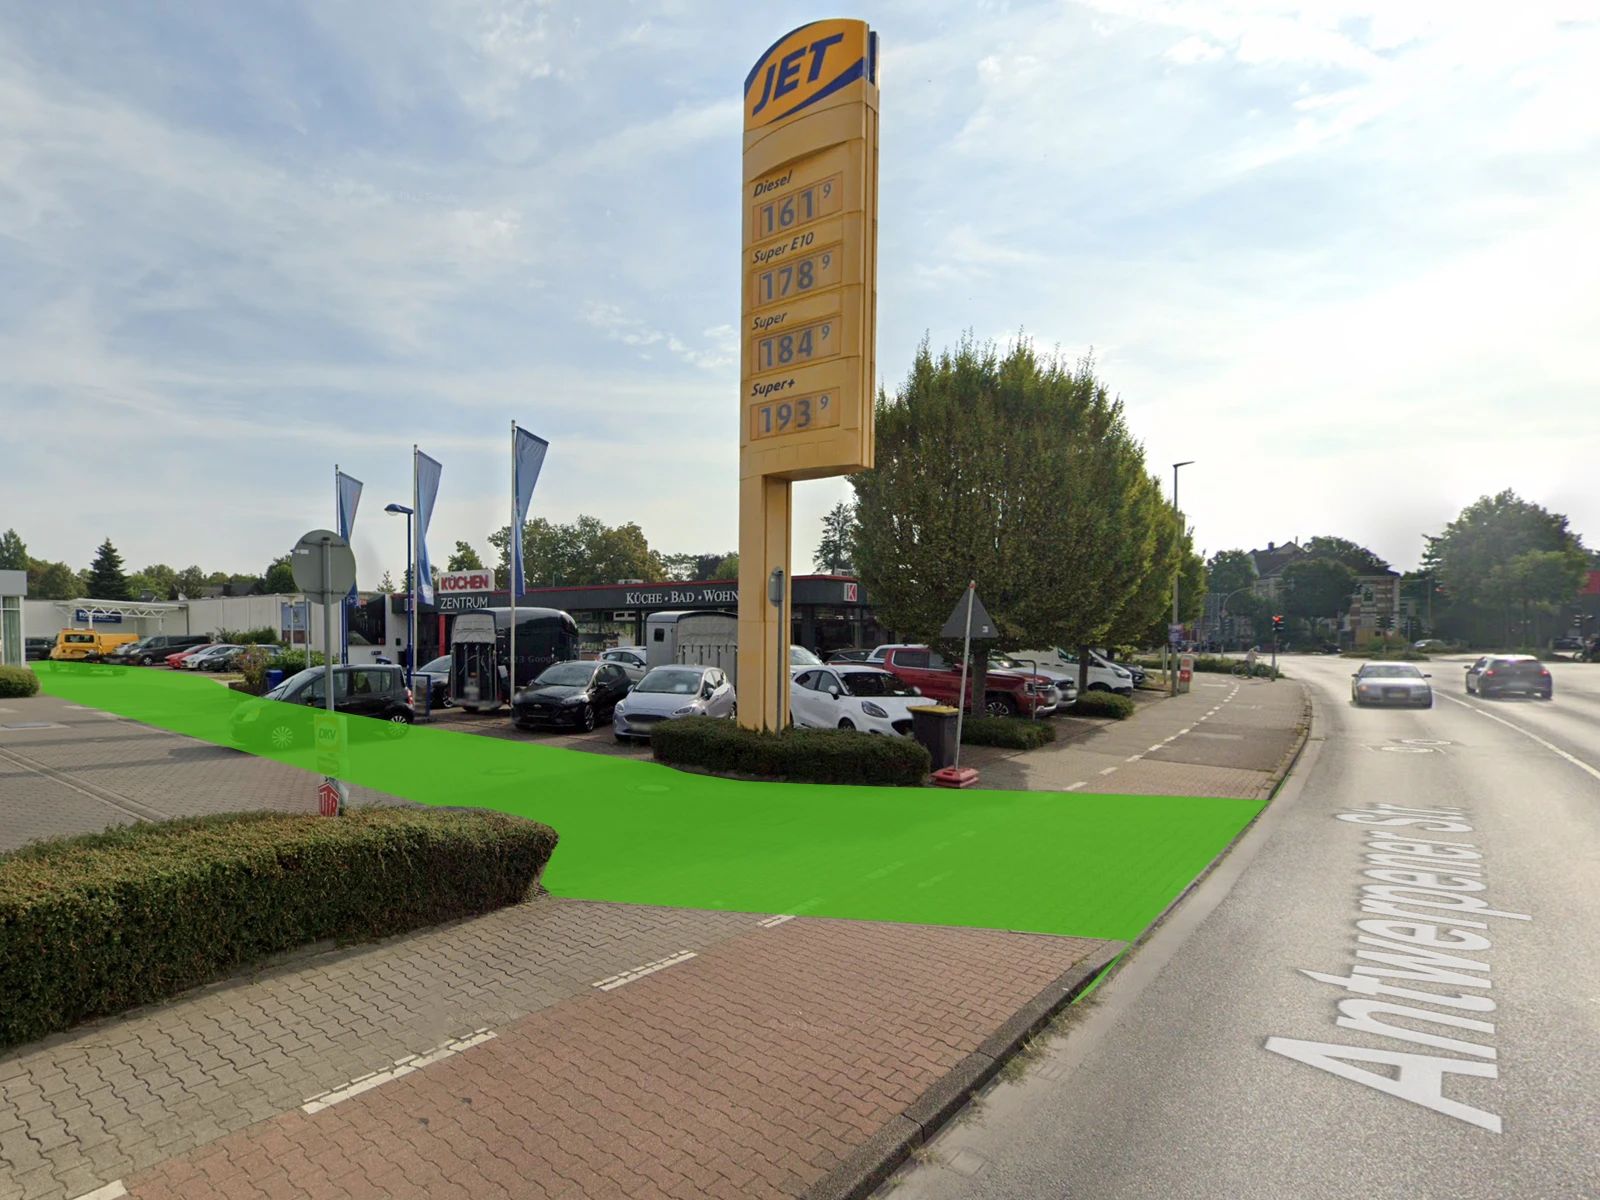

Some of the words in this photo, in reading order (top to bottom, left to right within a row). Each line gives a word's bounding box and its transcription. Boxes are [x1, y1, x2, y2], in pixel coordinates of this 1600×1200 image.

[752, 32, 844, 117] JET
[753, 169, 793, 198] Diesel
[762, 189, 815, 233] 161
[753, 244, 788, 264] Super
[790, 231, 814, 251] E10
[762, 258, 814, 300] 178
[752, 312, 788, 331] Super
[762, 328, 813, 368] 184
[751, 378, 795, 397] Super+
[760, 399, 812, 433] 193
[441, 574, 489, 591] KÜCHEN
[440, 596, 488, 610] ZENTRUM
[319, 728, 336, 740] DKV
[1335, 803, 1475, 832] Str.
[1264, 829, 1533, 1134] Antwerpener
